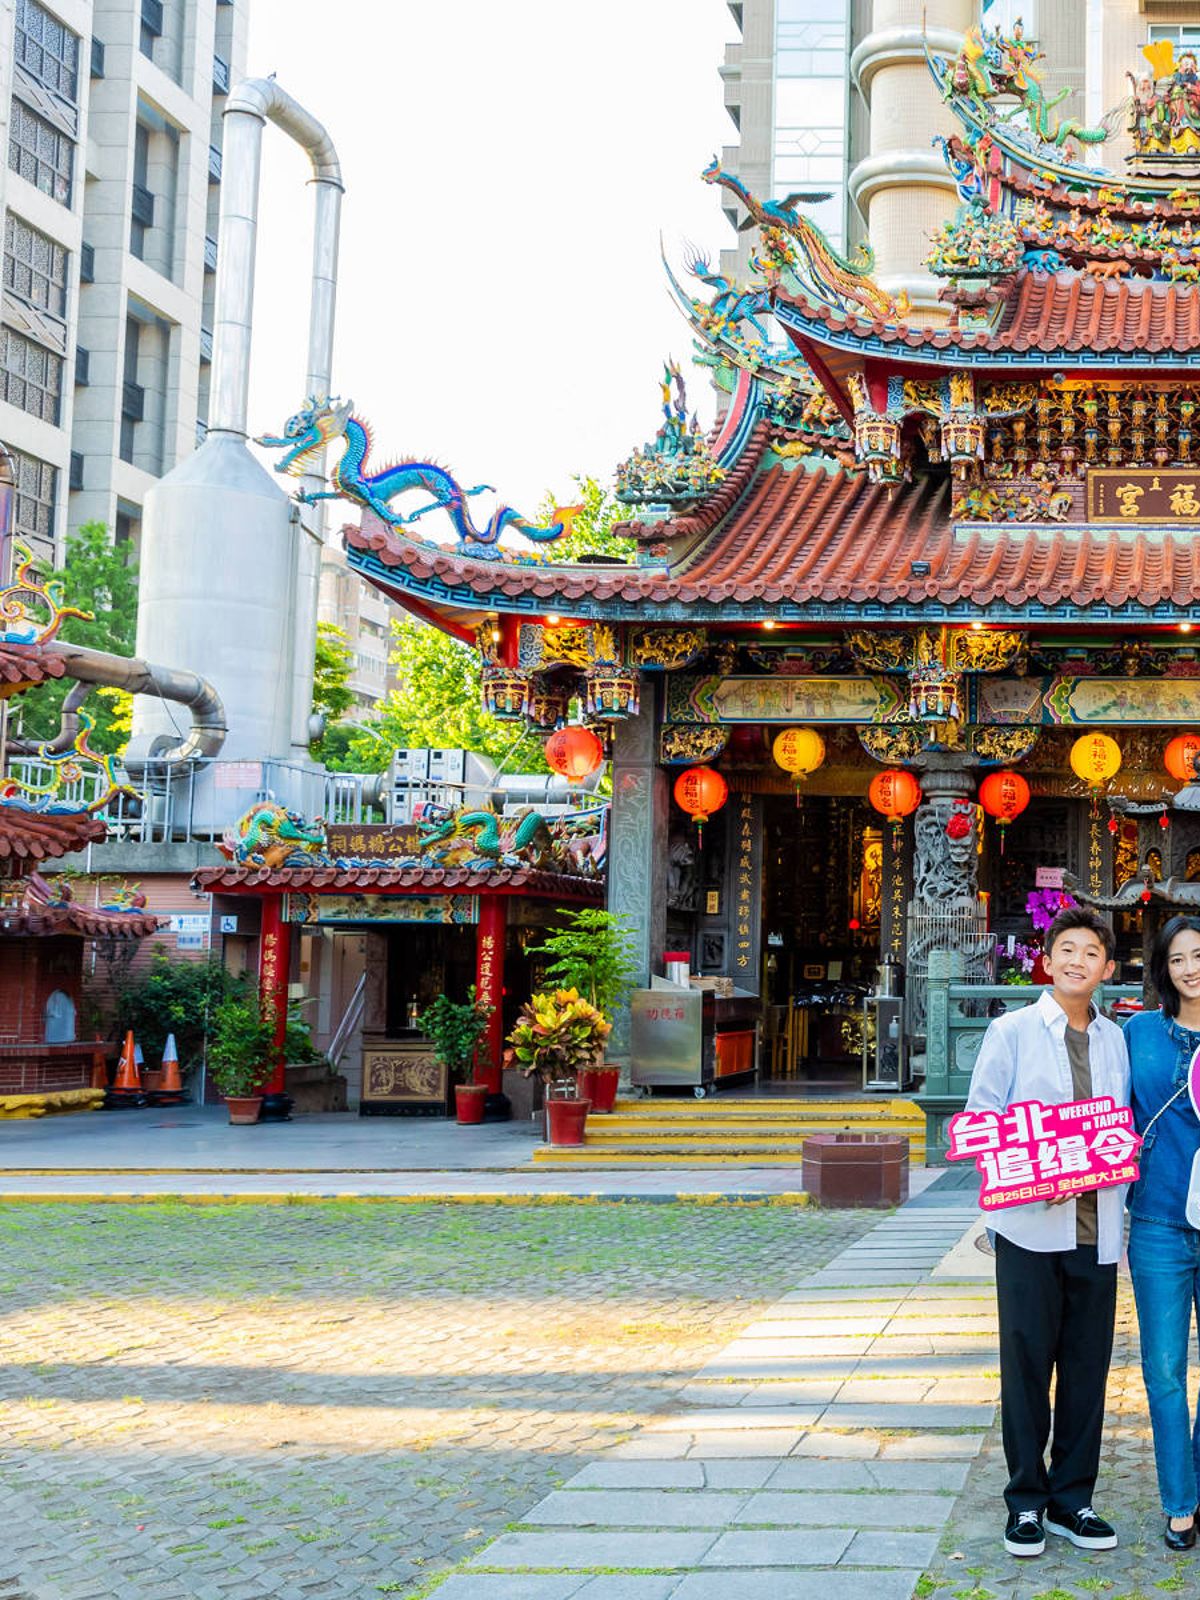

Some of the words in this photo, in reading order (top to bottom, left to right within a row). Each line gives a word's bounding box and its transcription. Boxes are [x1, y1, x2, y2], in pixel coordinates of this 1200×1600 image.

[782, 732, 797, 767] 植福宮
[1092, 738, 1106, 772] 植福宮
[684, 775, 699, 809] 植福宮
[878, 775, 893, 808] 植福宮
[1002, 778, 1017, 812] 植福宮
[1058, 1099, 1112, 1121] WEEKEND
[1093, 1110, 1129, 1130] TAIPEI
[951, 1103, 1056, 1156] 台北
[980, 1127, 1139, 1190] 追緝令
[983, 1184, 1055, 1206] 9月25日(三)
[1057, 1166, 1136, 1191] 全台盛大上映
